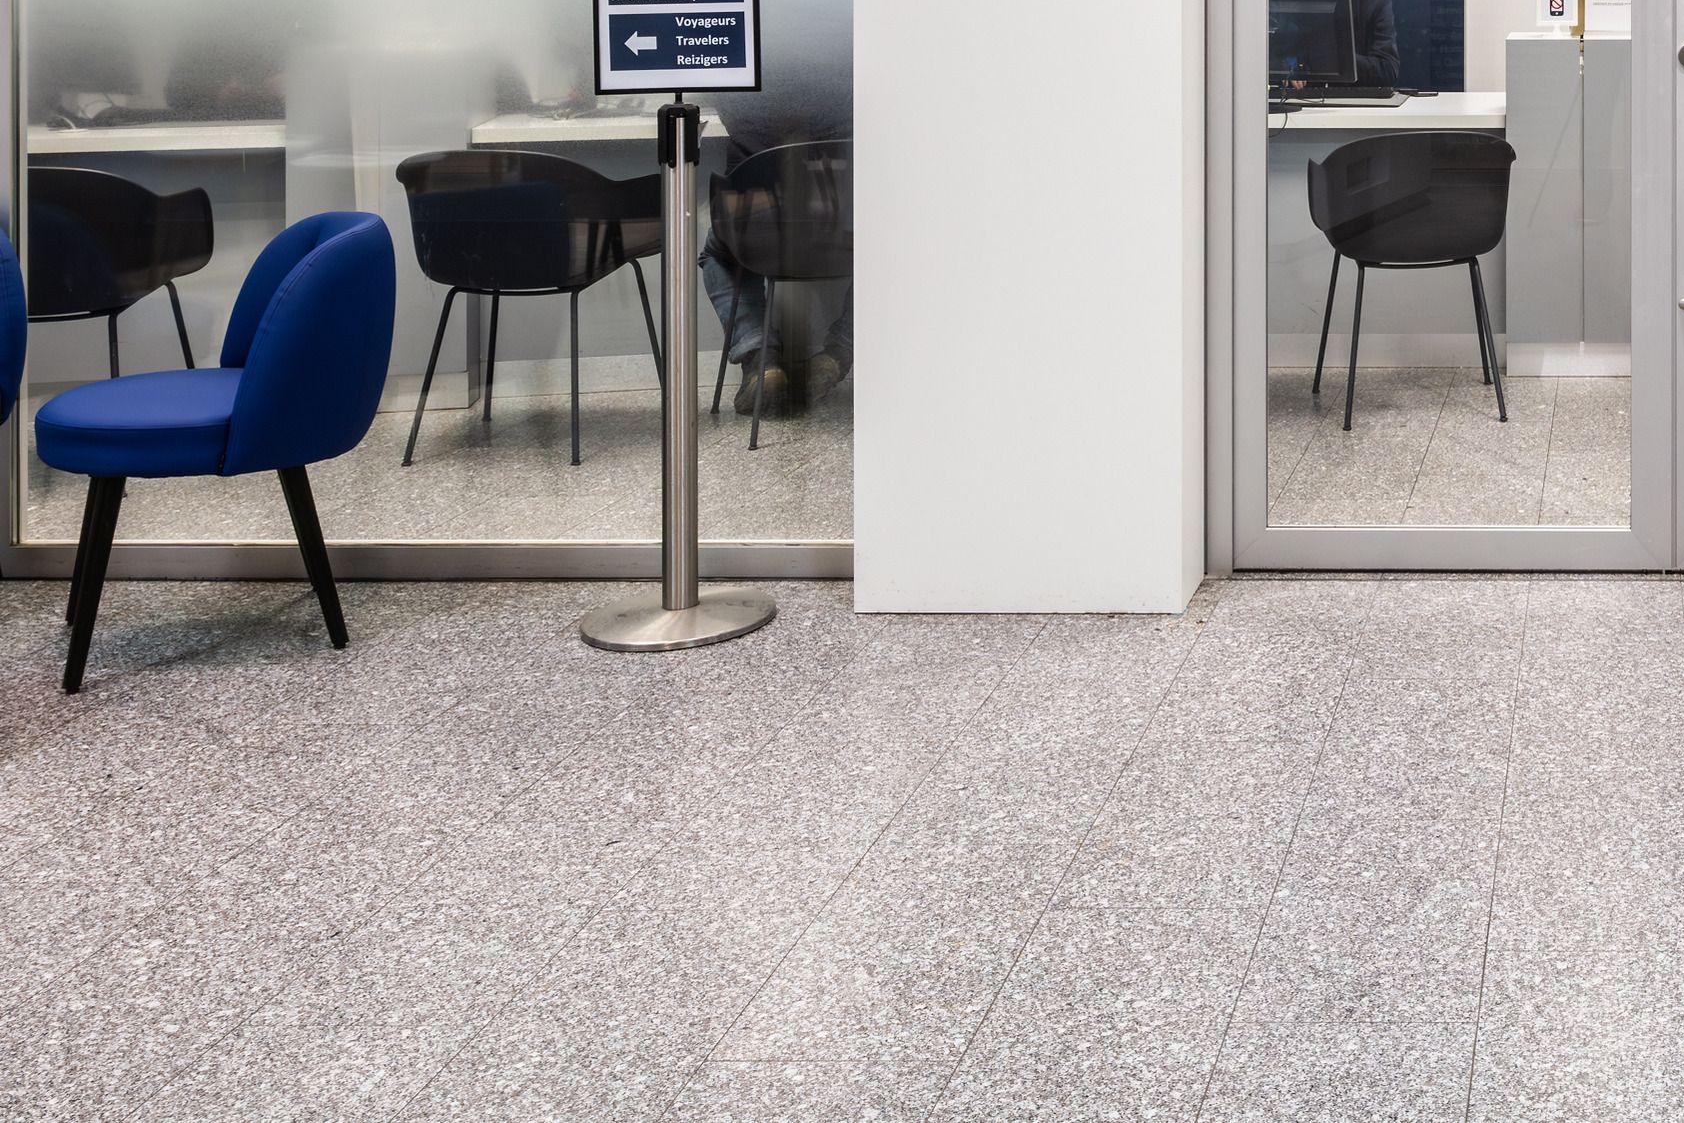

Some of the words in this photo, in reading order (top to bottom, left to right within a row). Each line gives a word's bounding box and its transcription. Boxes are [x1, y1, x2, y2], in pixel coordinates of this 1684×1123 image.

[675, 16, 736, 28] Voyageurs
[676, 35, 730, 46] Travelers
[677, 54, 728, 67] Reizigers
